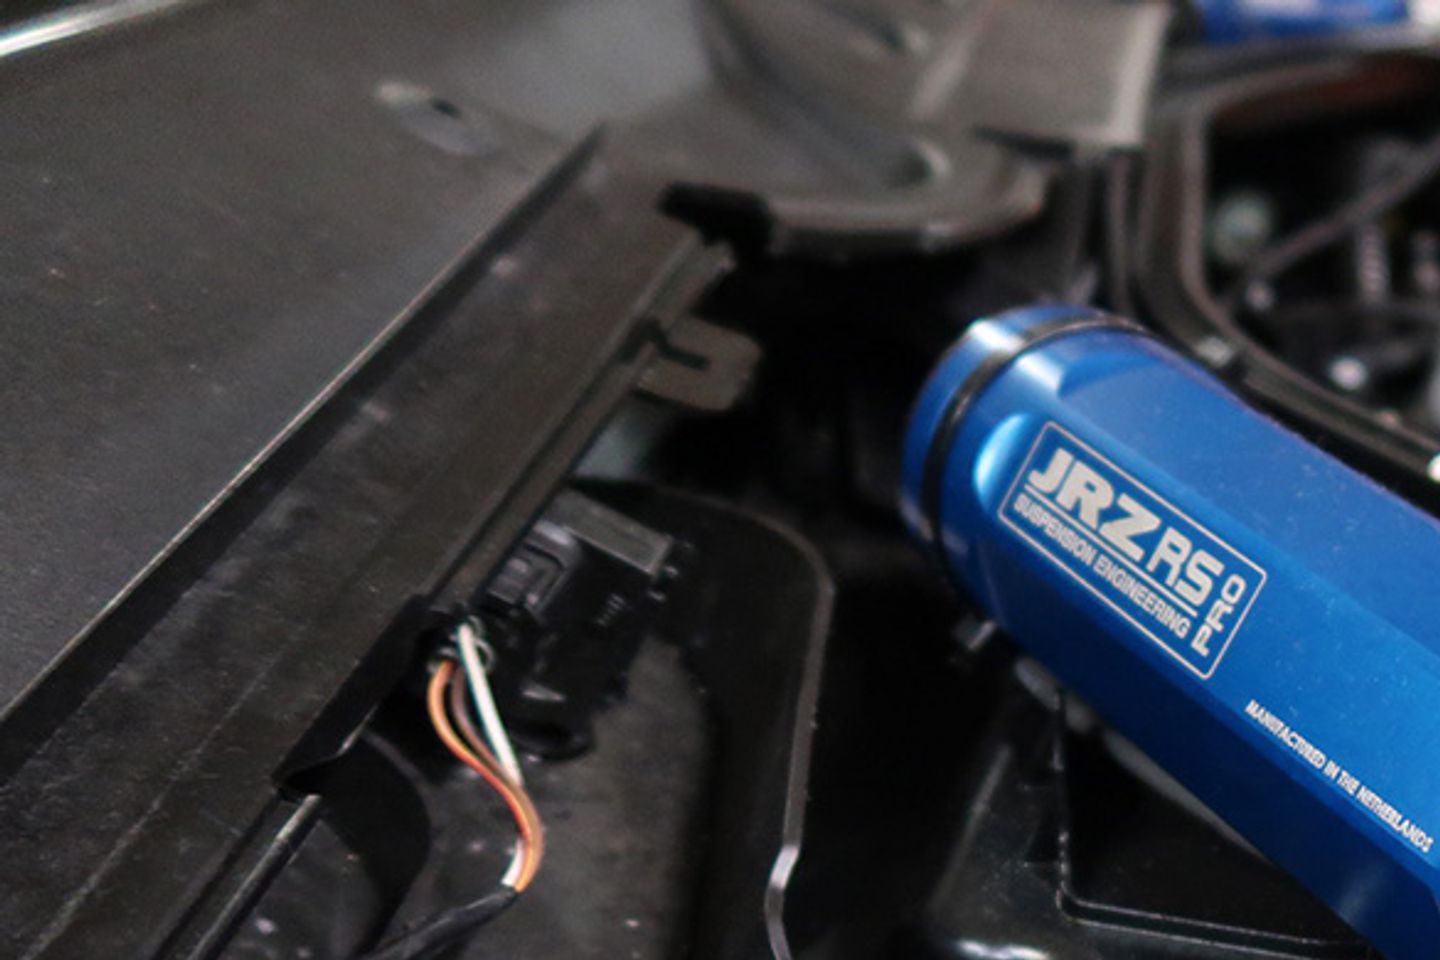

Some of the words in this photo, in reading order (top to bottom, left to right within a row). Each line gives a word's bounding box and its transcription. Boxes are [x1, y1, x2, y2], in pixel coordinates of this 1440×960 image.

[1013, 492, 1100, 566] SUSPENSION
[1092, 553, 1192, 639] ENGINEERING
[1027, 447, 1162, 562] JRZ
[1145, 527, 1226, 606] RS
[1190, 573, 1247, 657] PRO
[1323, 760, 1340, 779] IN
[1337, 769, 1360, 796] THE
[1356, 785, 1434, 853] NETHERLANDS
